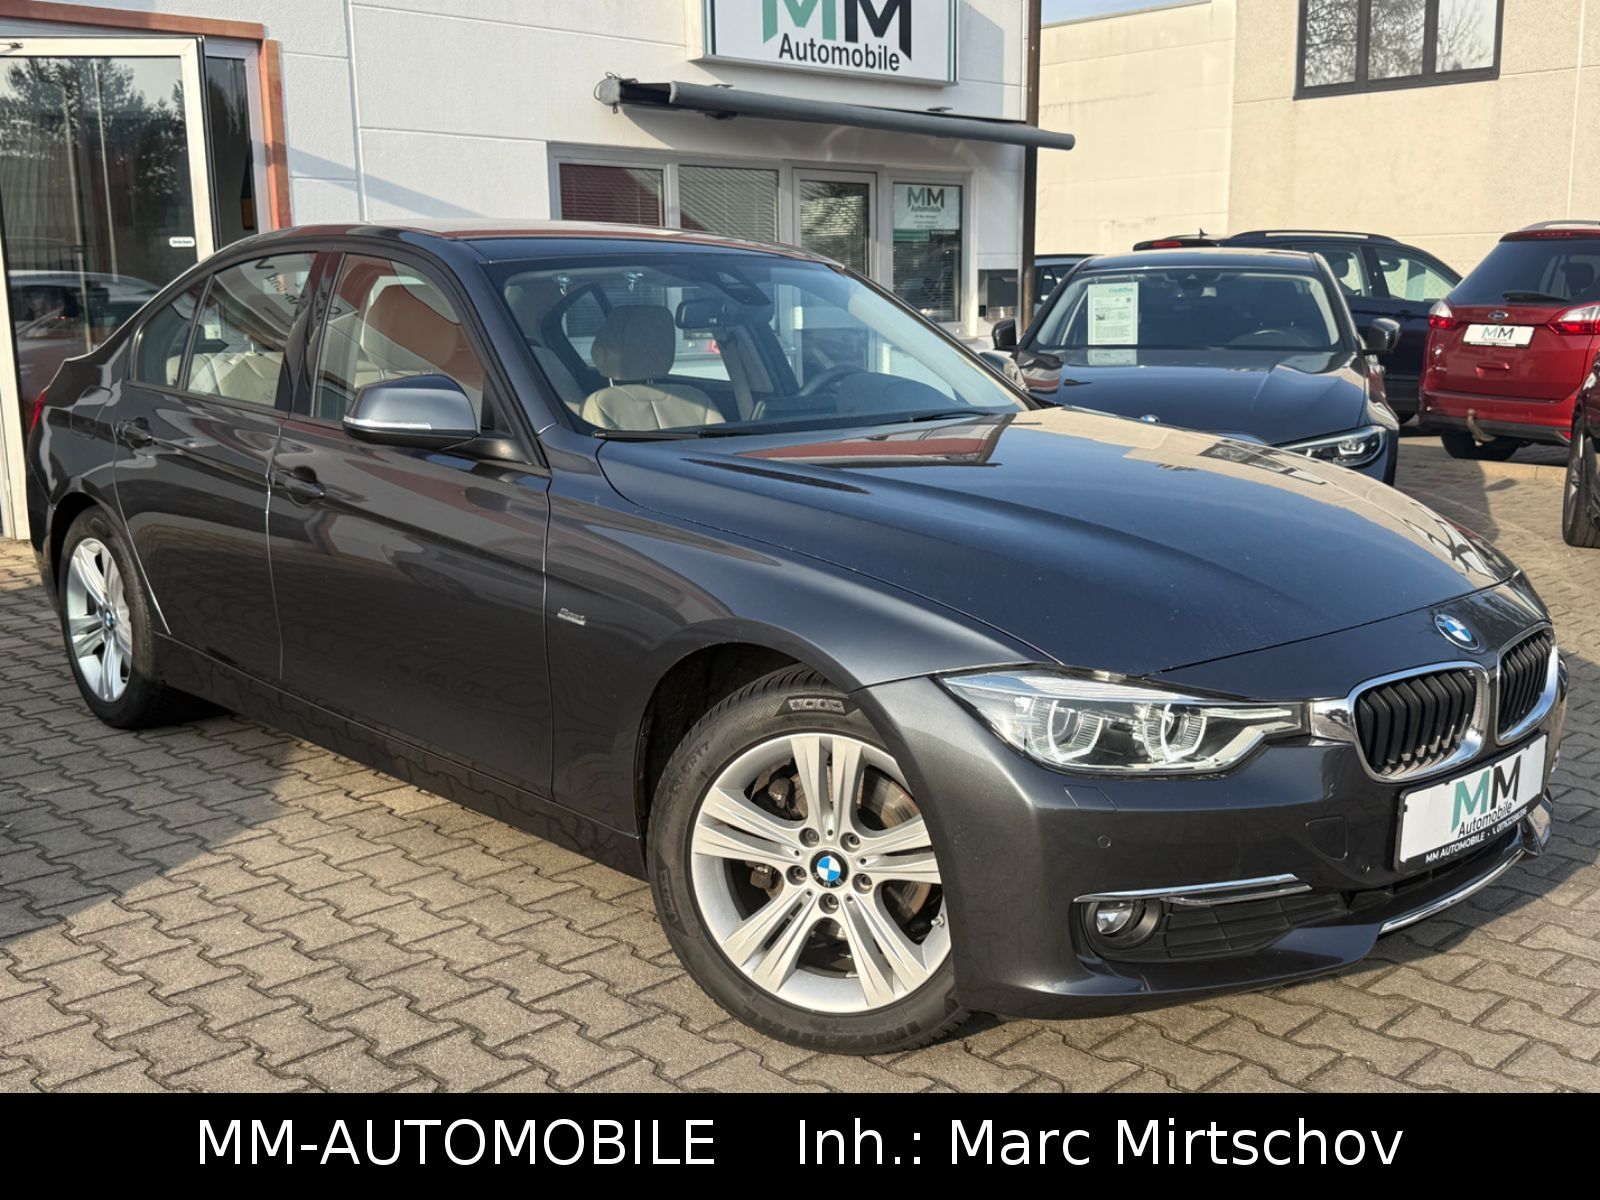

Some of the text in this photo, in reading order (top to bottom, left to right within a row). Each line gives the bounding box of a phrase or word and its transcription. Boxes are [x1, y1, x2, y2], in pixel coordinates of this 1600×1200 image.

[762, 0, 912, 61] MM
[778, 33, 900, 71] Automobile
[907, 186, 945, 209] MM
[1481, 326, 1515, 340] MM
[1450, 754, 1522, 834] MM
[1457, 801, 1513, 838] Automobile
[1425, 832, 1486, 864] MM AUTOMOBILE
